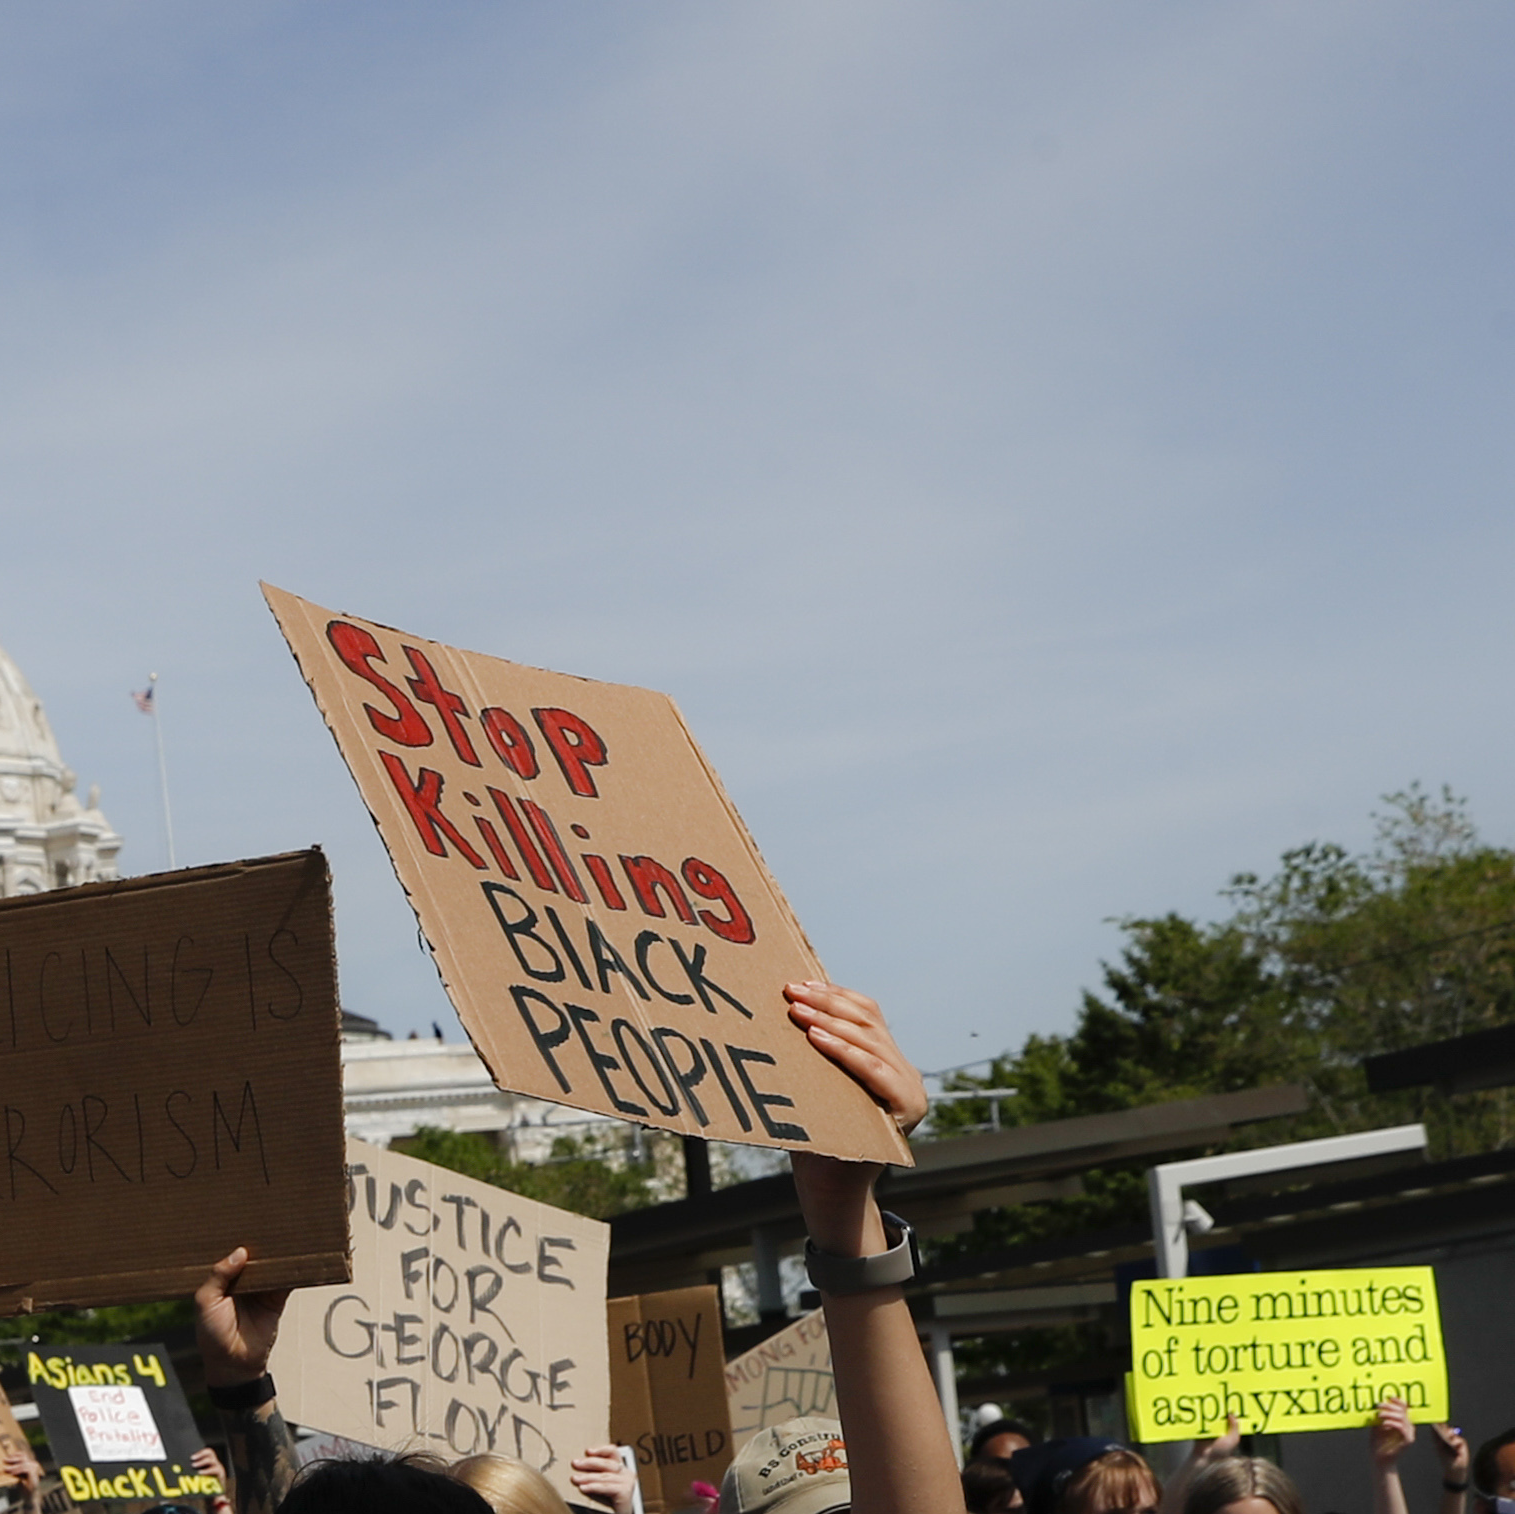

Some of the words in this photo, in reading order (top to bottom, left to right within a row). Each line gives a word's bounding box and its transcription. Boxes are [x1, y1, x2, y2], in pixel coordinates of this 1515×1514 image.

[326, 620, 608, 798] Stop
[378, 750, 756, 945] Killing
[245, 929, 304, 1033] IS
[401, 1247, 516, 1343] FOR
[1142, 1286, 1239, 1328] Nine
[1251, 1279, 1425, 1321] minutes
[133, 1354, 166, 1387] 4
[324, 1294, 577, 1411] GEORGE
[624, 1313, 701, 1379] BODY
[723, 1341, 794, 1397] MONG
[1142, 1336, 1178, 1379] of
[1193, 1336, 1341, 1375] torture
[1351, 1324, 1432, 1367] and
[88, 1388, 125, 1404] End
[366, 1377, 558, 1474] FLOYD
[1153, 1373, 1430, 1435] asphyxiation
[637, 1430, 725, 1467] SHIELD
